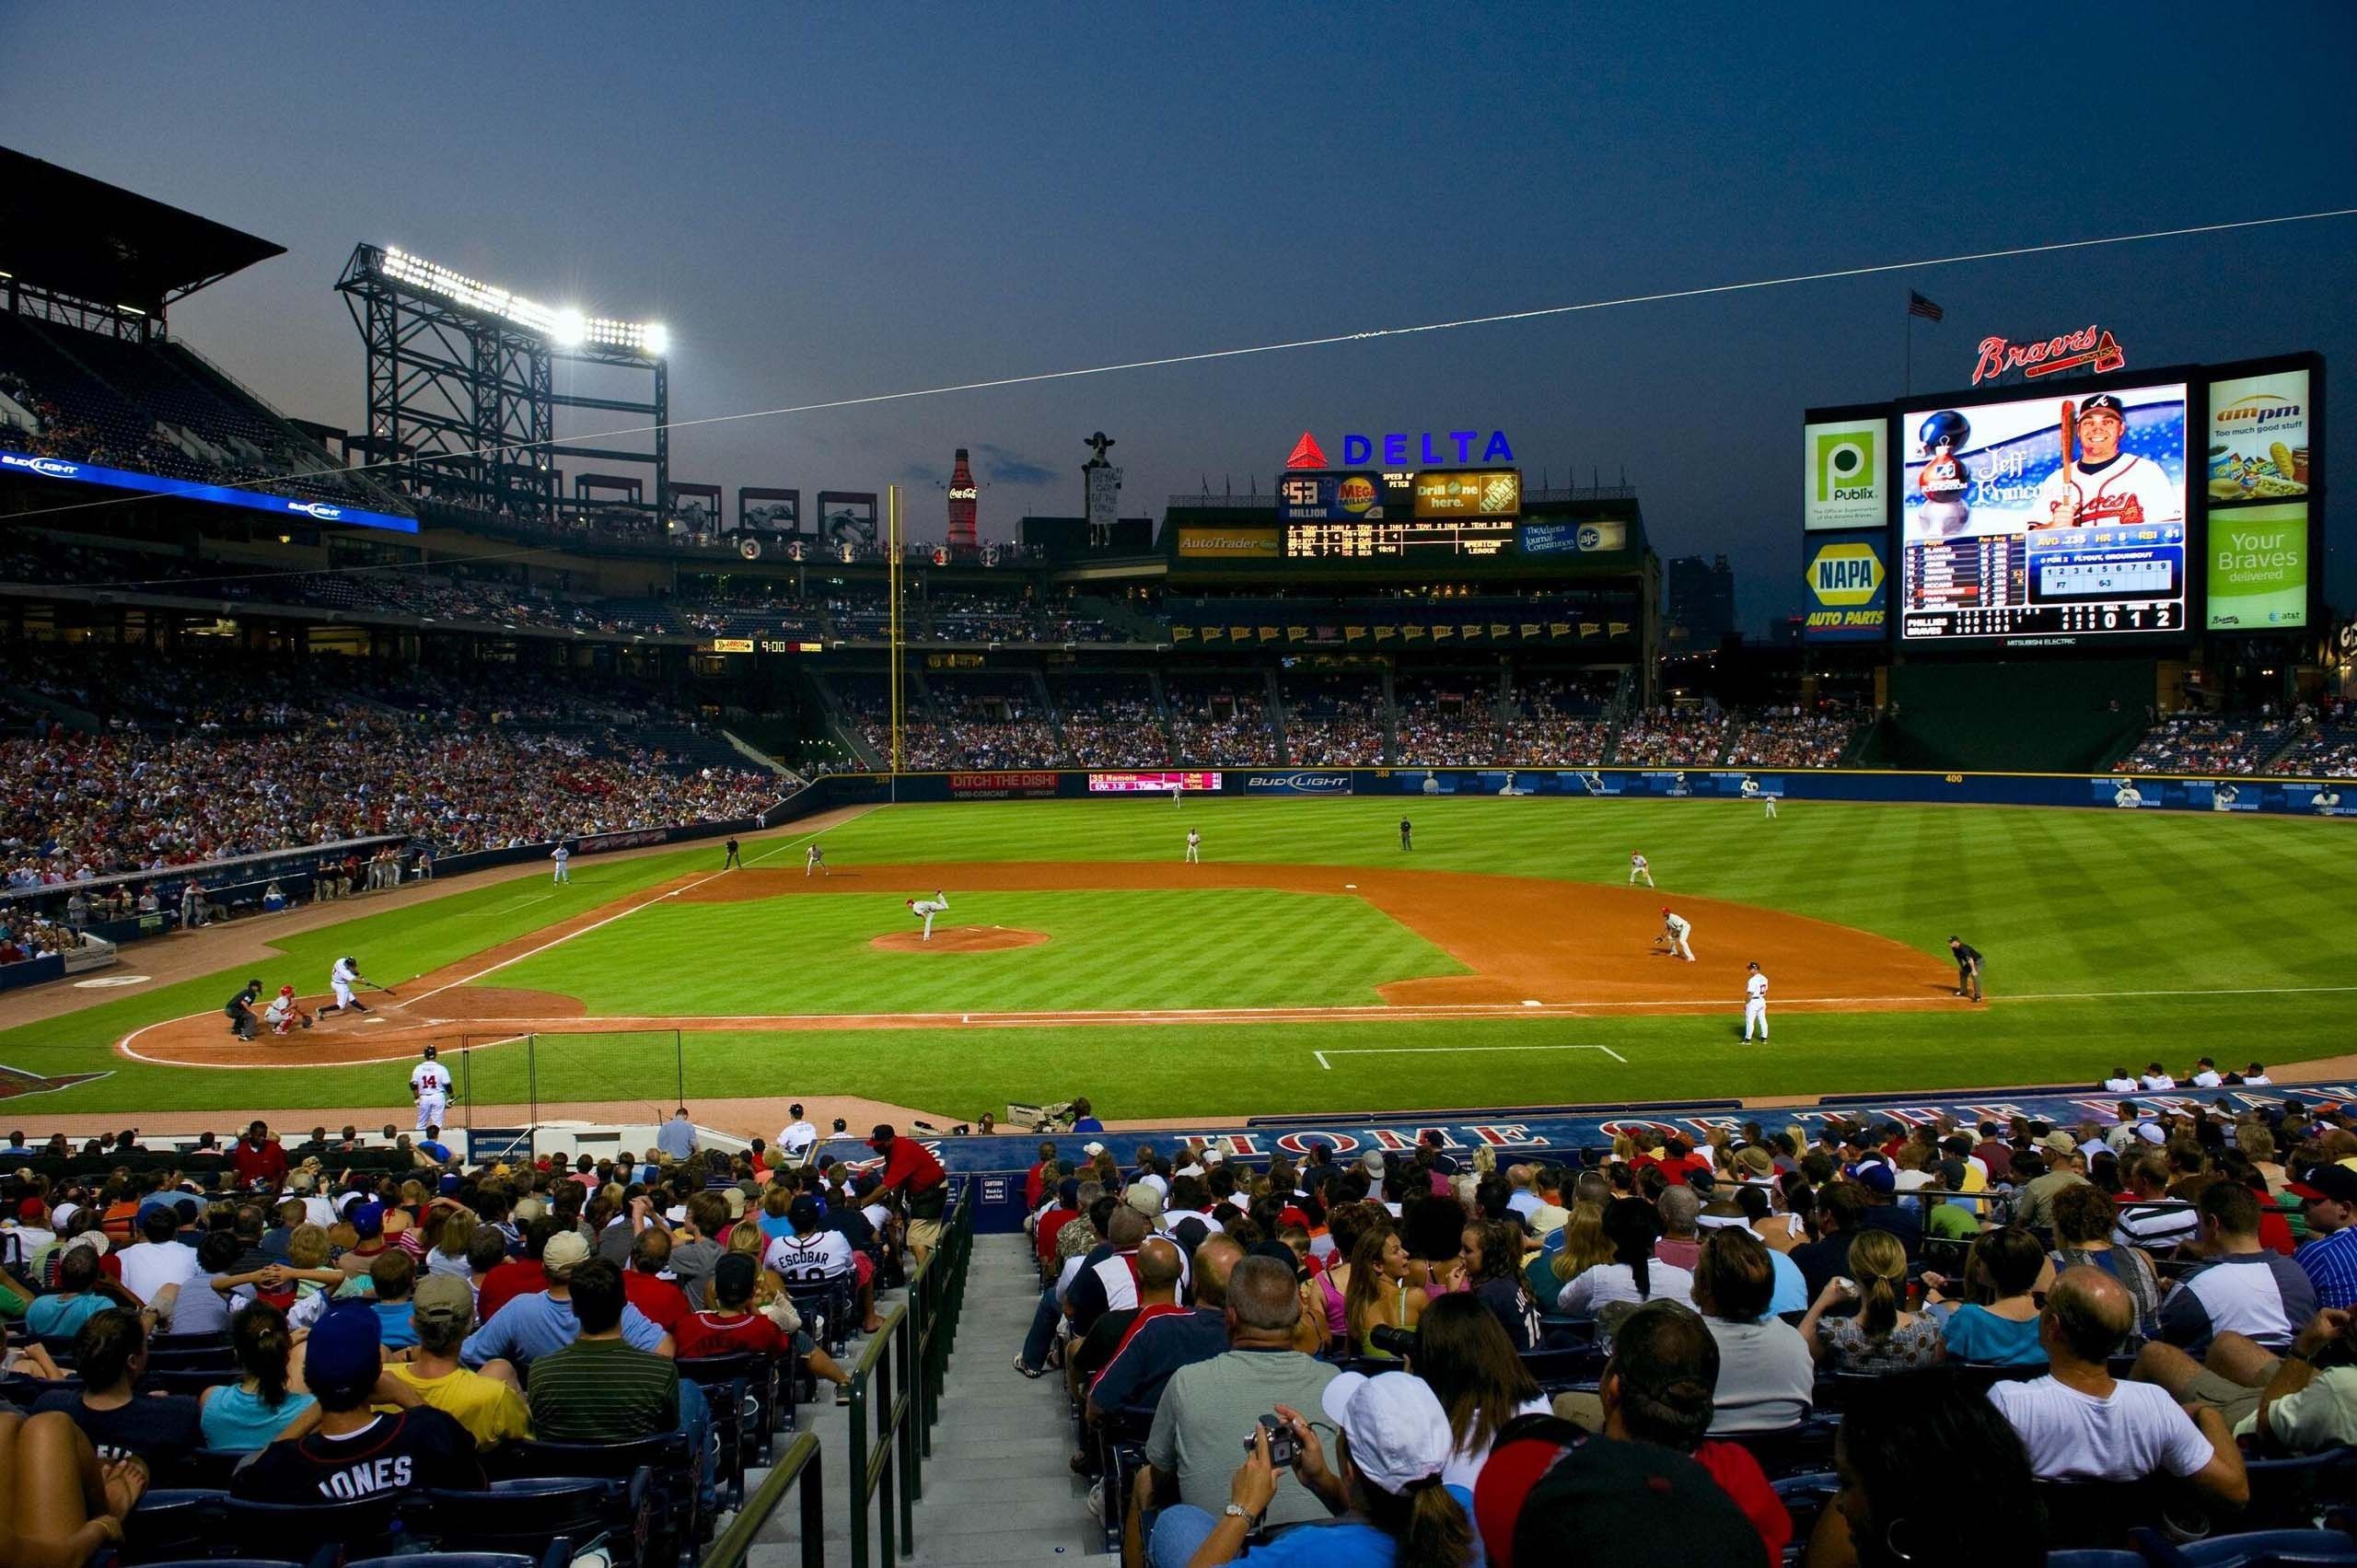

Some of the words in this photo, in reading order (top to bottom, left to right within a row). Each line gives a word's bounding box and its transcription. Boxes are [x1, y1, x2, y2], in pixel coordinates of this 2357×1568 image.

[1972, 324, 2098, 386] Braves
[2216, 405, 2301, 424] ampm
[2232, 426, 2255, 436] much
[2257, 424, 2280, 434] good
[2282, 421, 2303, 429] stuff
[1343, 430, 1514, 465] DELTA
[2, 456, 30, 467] BUD
[36, 460, 79, 474] LIGHT
[1980, 447, 2027, 479] Jeff
[1383, 472, 1403, 481] SPEED
[949, 487, 978, 499] Coca-Cola
[1339, 483, 1376, 498] MEGA
[1418, 484, 1446, 495] Drill
[1480, 475, 1519, 511] HOME
[1484, 479, 1501, 494] THE
[1339, 496, 1374, 506] MILLION
[1494, 489, 1517, 512] DEPOT
[1834, 487, 1875, 501] Publix
[1431, 497, 1464, 507] here.
[1289, 507, 1328, 518] MILLION
[1525, 526, 1538, 535] The
[1538, 524, 1566, 536] Atlanta
[1180, 537, 1259, 549] AutoTrader
[1527, 538, 1574, 552] Constitution
[1580, 532, 1598, 545] ajc
[2038, 537, 2060, 546] AVG
[2095, 534, 2111, 543] HR
[2138, 530, 2158, 540] RBI
[2232, 533, 2285, 552] Your
[745, 543, 756, 556] 3
[981, 552, 999, 566] 42
[2219, 552, 2298, 570] Braves
[1819, 559, 1874, 590] NAPA
[2229, 569, 2283, 582] delivered
[2098, 579, 2111, 587] 6-3
[1805, 611, 1843, 627] AUTO
[1843, 610, 1886, 626] PARTS
[1907, 618, 1948, 627] PHILLIES
[2104, 612, 2117, 628] 0
[2130, 611, 2141, 627] 1
[2156, 610, 2170, 627] 2
[1907, 627, 1943, 636] BRAVES
[1956, 626, 1962, 634] 0
[761, 641, 785, 653] 9:00
[2043, 637, 2076, 645] ELECTRIC
[875, 775, 891, 784] 335
[953, 775, 992, 787] DITCH
[994, 774, 1020, 787] THE
[1022, 773, 1055, 786] DISH!
[1092, 773, 1104, 782] 35
[1248, 777, 1287, 786] BUD
[1295, 777, 1349, 786] LIGHT
[1945, 774, 1963, 784] 400
[422, 1074, 437, 1089] 14
[1174, 1122, 1551, 1157] HOME
[1791, 1102, 2057, 1131] THE
[2068, 1086, 2357, 1121] BRAV
[778, 1250, 830, 1269] ESCOBAR
